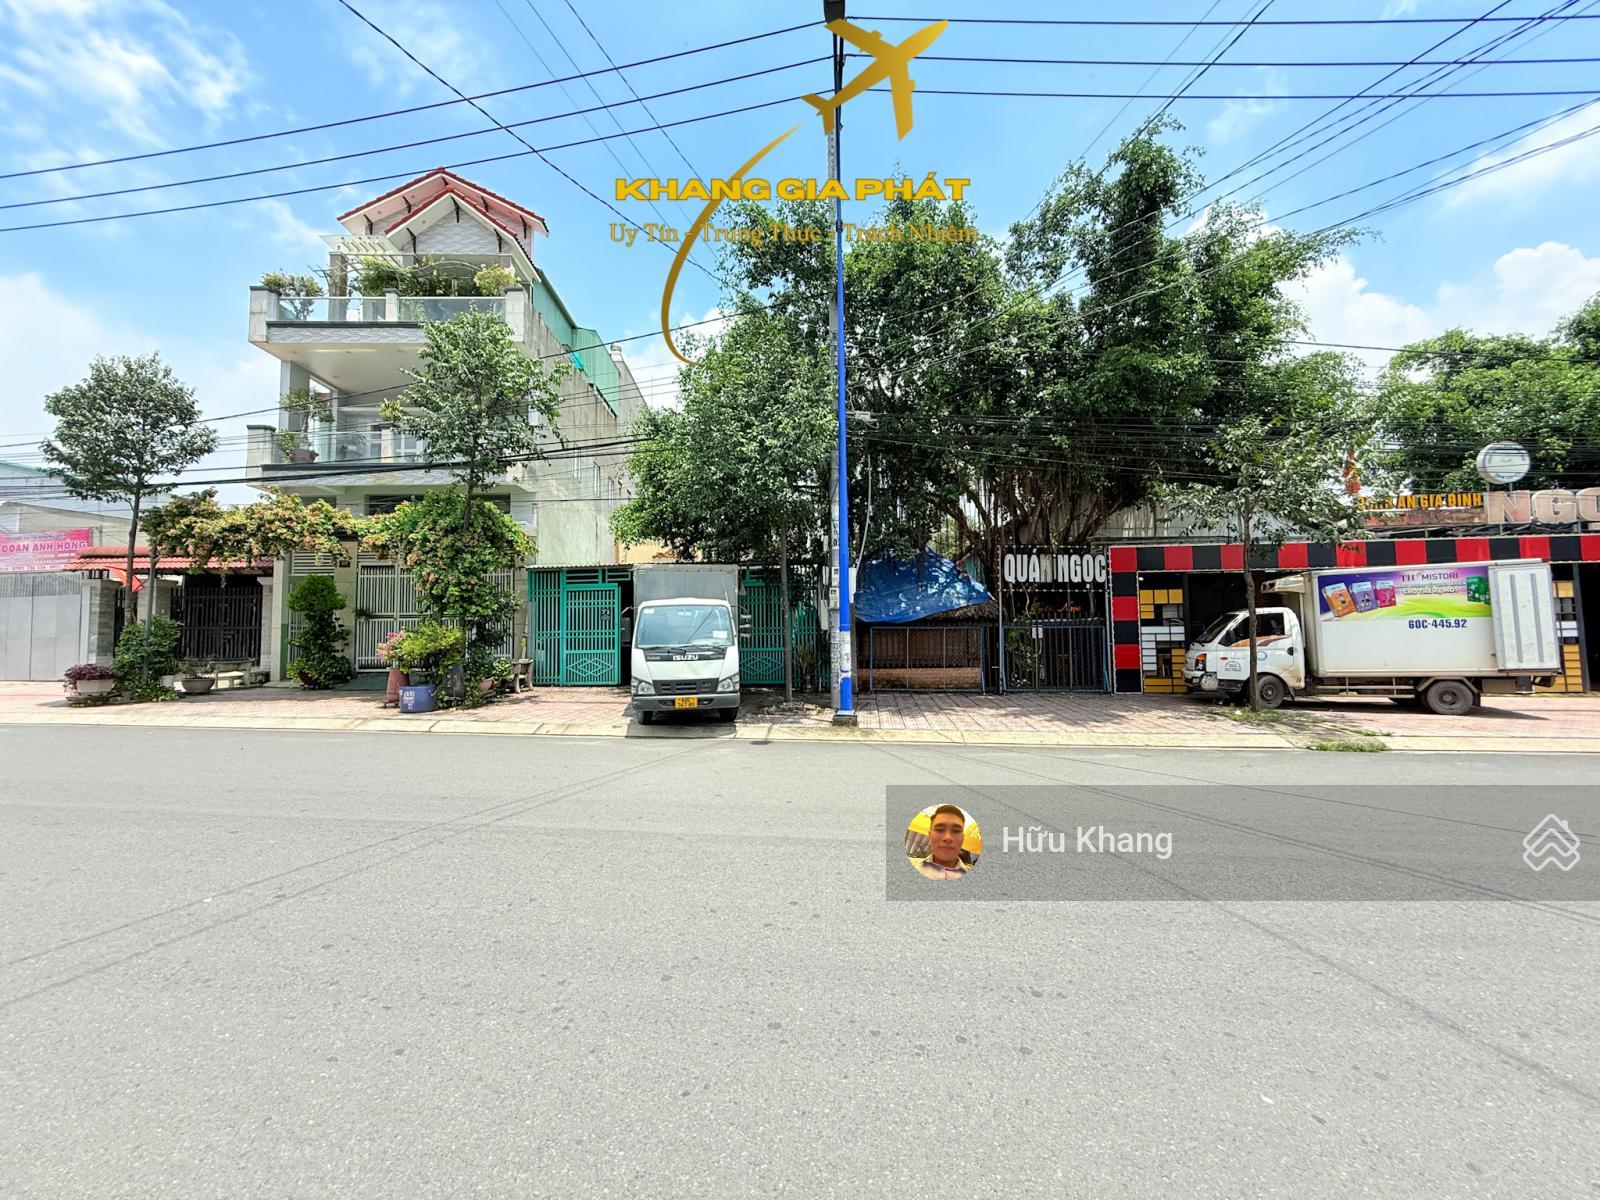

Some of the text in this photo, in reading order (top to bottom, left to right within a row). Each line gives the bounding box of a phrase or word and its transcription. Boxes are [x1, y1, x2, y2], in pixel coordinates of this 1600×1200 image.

[1003, 547, 1107, 589] QUÁN NGỌC
[1421, 572, 1459, 580] MISTORI
[1408, 618, 1468, 629] 60C-445.92
[672, 653, 699, 661] ISUZU
